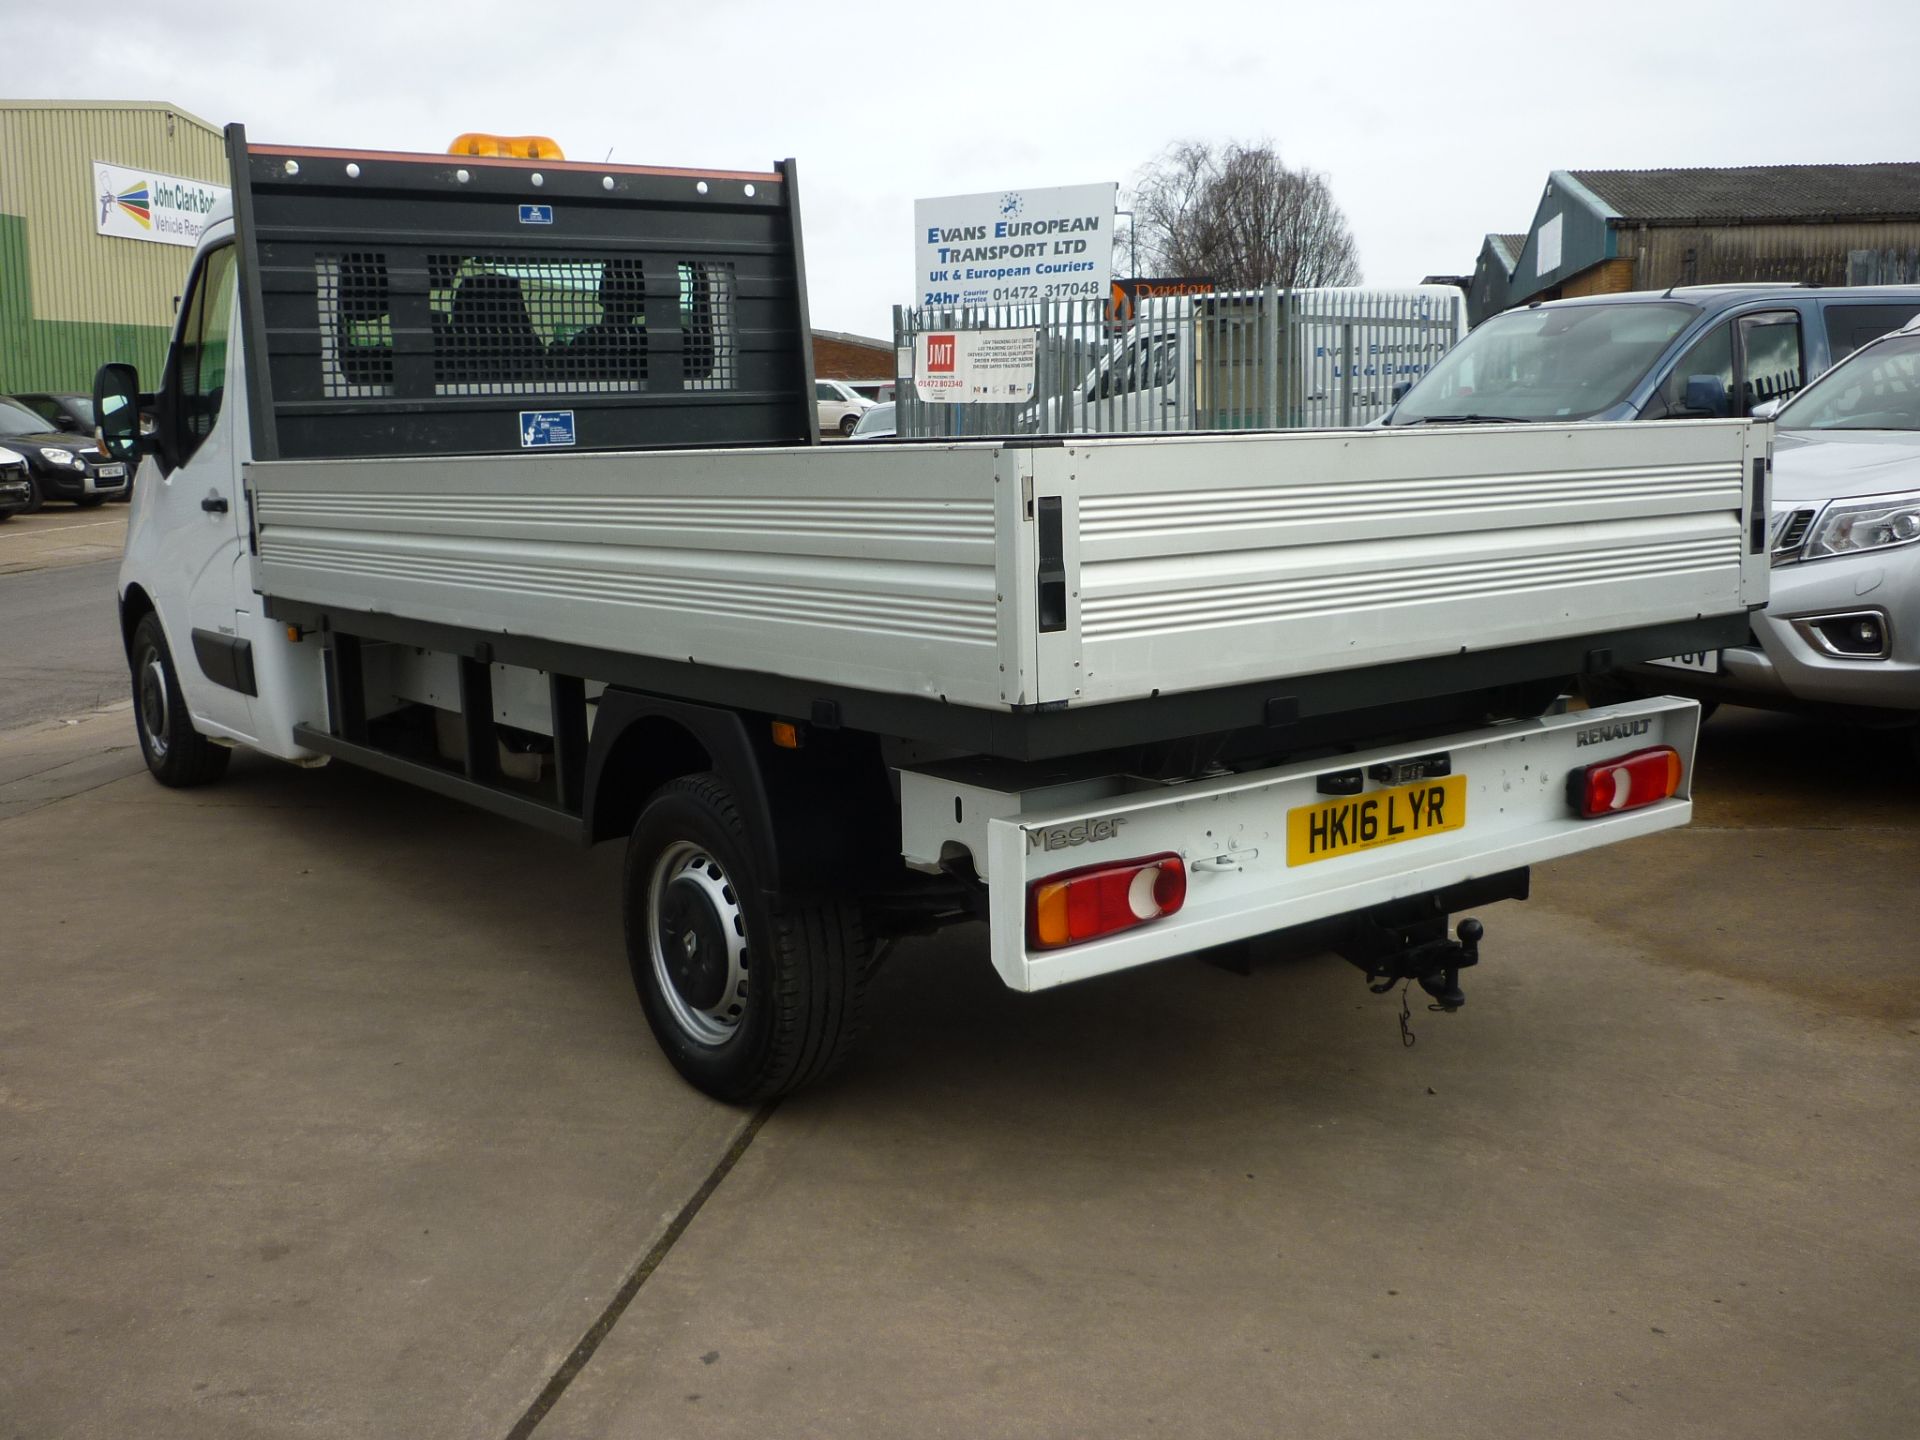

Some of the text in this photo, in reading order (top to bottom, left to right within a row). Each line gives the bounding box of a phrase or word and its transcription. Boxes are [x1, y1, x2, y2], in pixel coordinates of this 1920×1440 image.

[153, 181, 216, 214] John Clark Bod
[154, 215, 183, 232] Vehicle
[927, 216, 1100, 244] EVANS EUROPEAN
[937, 239, 1087, 264] TRANSPORT LTD
[929, 261, 1095, 283] UK & European Couriers
[925, 281, 1100, 306] 24hr 01472 317048
[963, 296, 987, 304] Service
[928, 344, 953, 366] JMT
[1316, 346, 1359, 358] EVAS
[918, 380, 938, 388] 01472
[1576, 718, 1653, 748] RENAULT
[1309, 786, 1445, 854] HK16 LYR
[1025, 818, 1129, 856] Master
